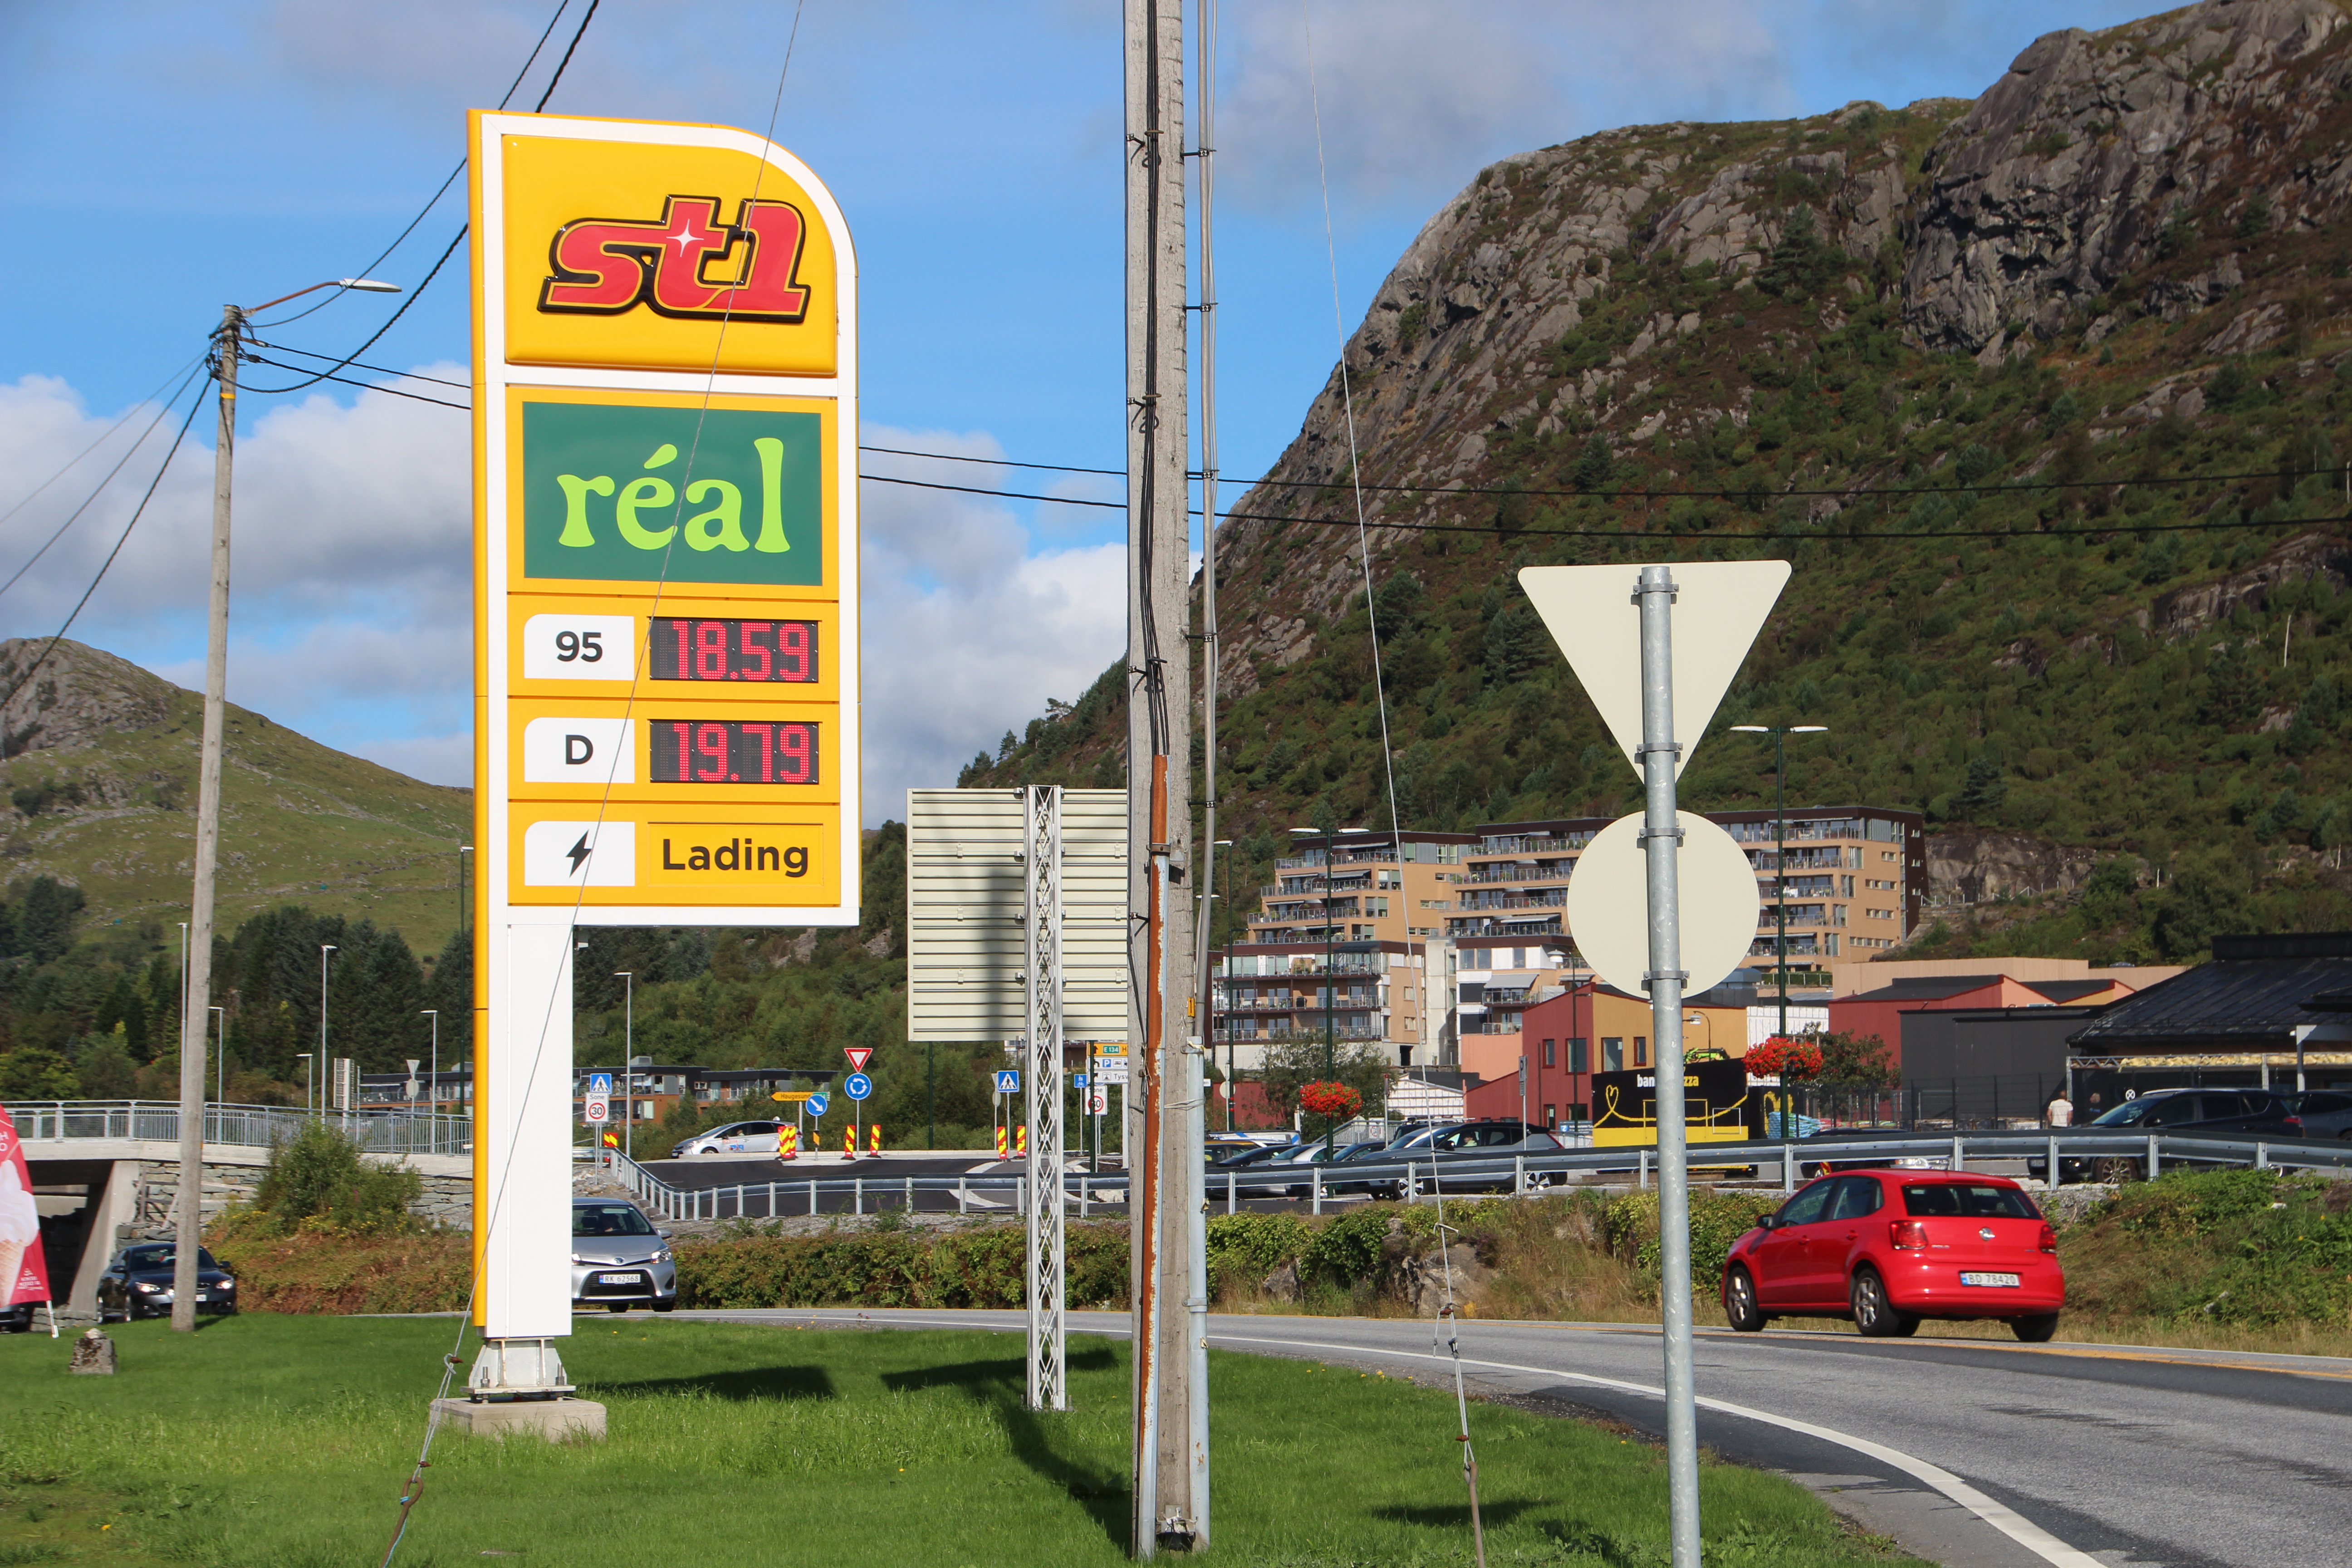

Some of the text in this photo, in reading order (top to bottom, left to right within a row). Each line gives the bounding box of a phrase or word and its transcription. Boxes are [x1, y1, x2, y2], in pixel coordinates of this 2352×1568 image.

[537, 194, 811, 323] st1
[556, 437, 790, 553] réal
[556, 632, 603, 662] 95
[672, 620, 809, 681] 18.59
[565, 735, 593, 765] D
[673, 722, 809, 784] 19.79
[662, 838, 808, 878] Lading
[1637, 1074, 1699, 1087] ban zza
[1968, 1274, 2016, 1284] BD 78420
